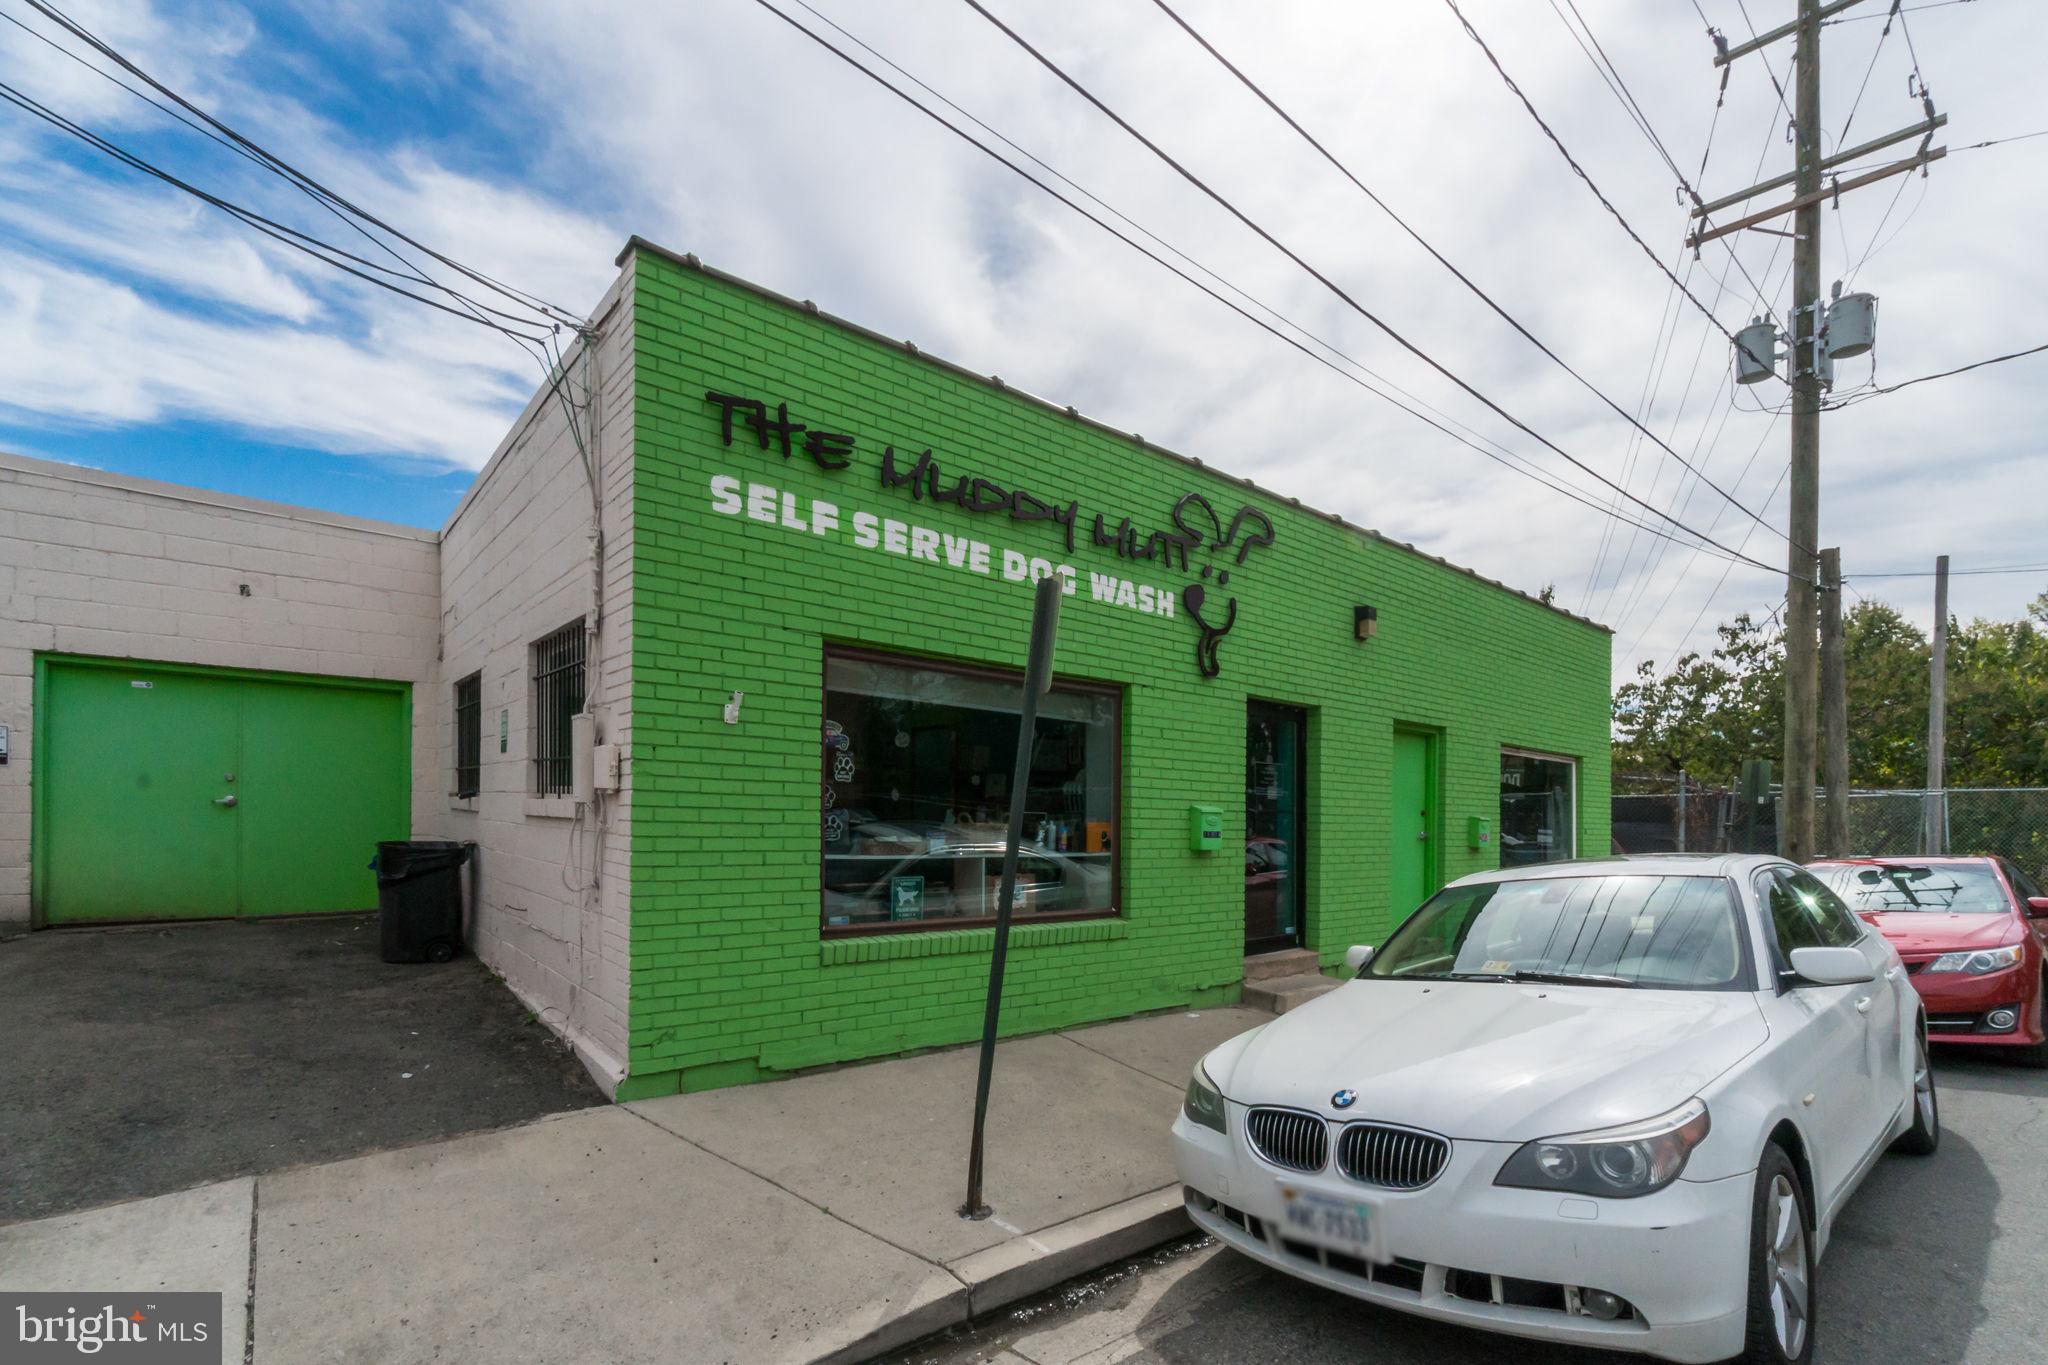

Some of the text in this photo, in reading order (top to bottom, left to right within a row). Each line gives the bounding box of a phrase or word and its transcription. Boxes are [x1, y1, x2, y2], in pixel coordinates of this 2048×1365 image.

[705, 390, 1203, 572] THE MUDDY MUTT
[710, 474, 1174, 618] SELF SERVE DOG WASH
